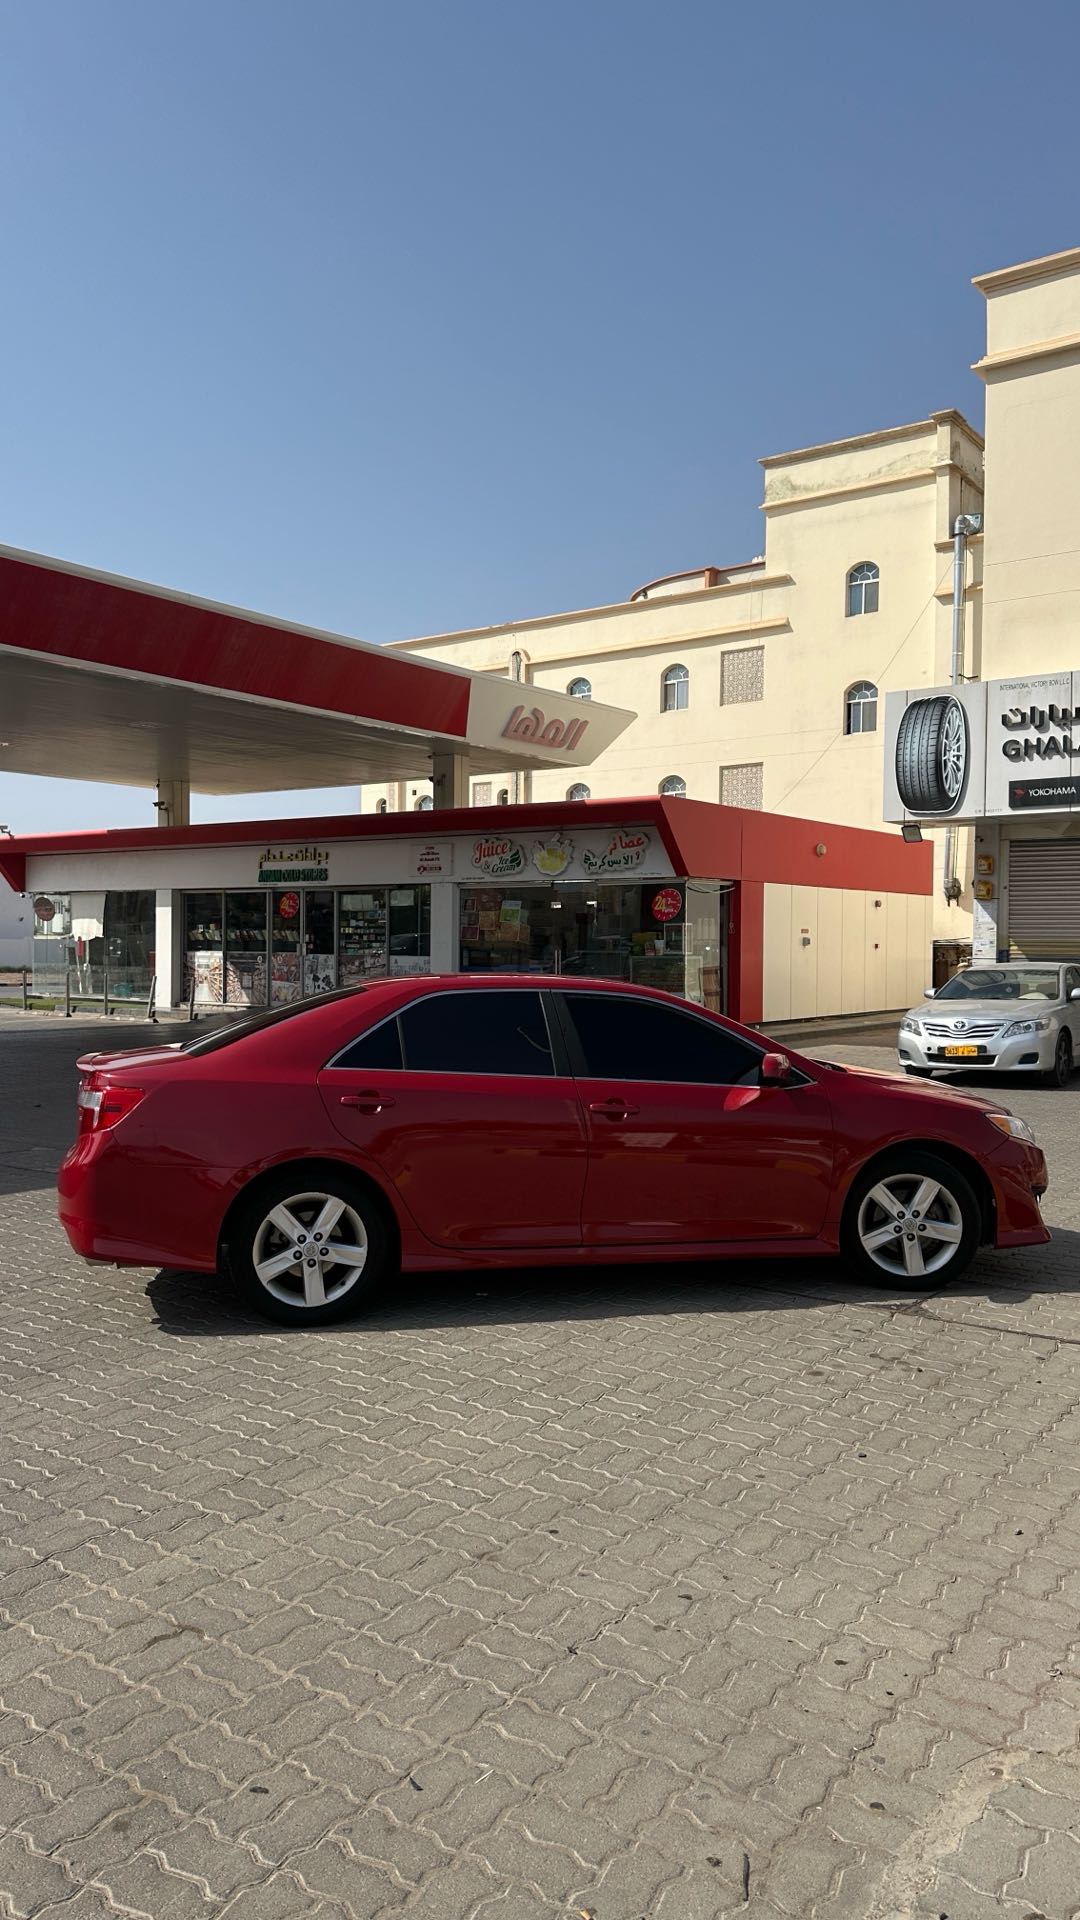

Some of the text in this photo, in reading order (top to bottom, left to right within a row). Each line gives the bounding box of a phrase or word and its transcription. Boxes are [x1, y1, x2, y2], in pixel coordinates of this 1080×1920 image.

[501, 704, 590, 751] المها
[1002, 734, 1080, 761] GHAL
[1028, 786, 1077, 797] YOKOHAMA
[474, 840, 508, 864] Juice
[483, 861, 515, 873] & Cream
[498, 856, 509, 865] Ice
[282, 869, 300, 882] COLD
[301, 868, 329, 881] STORES
[655, 896, 666, 910] 24
